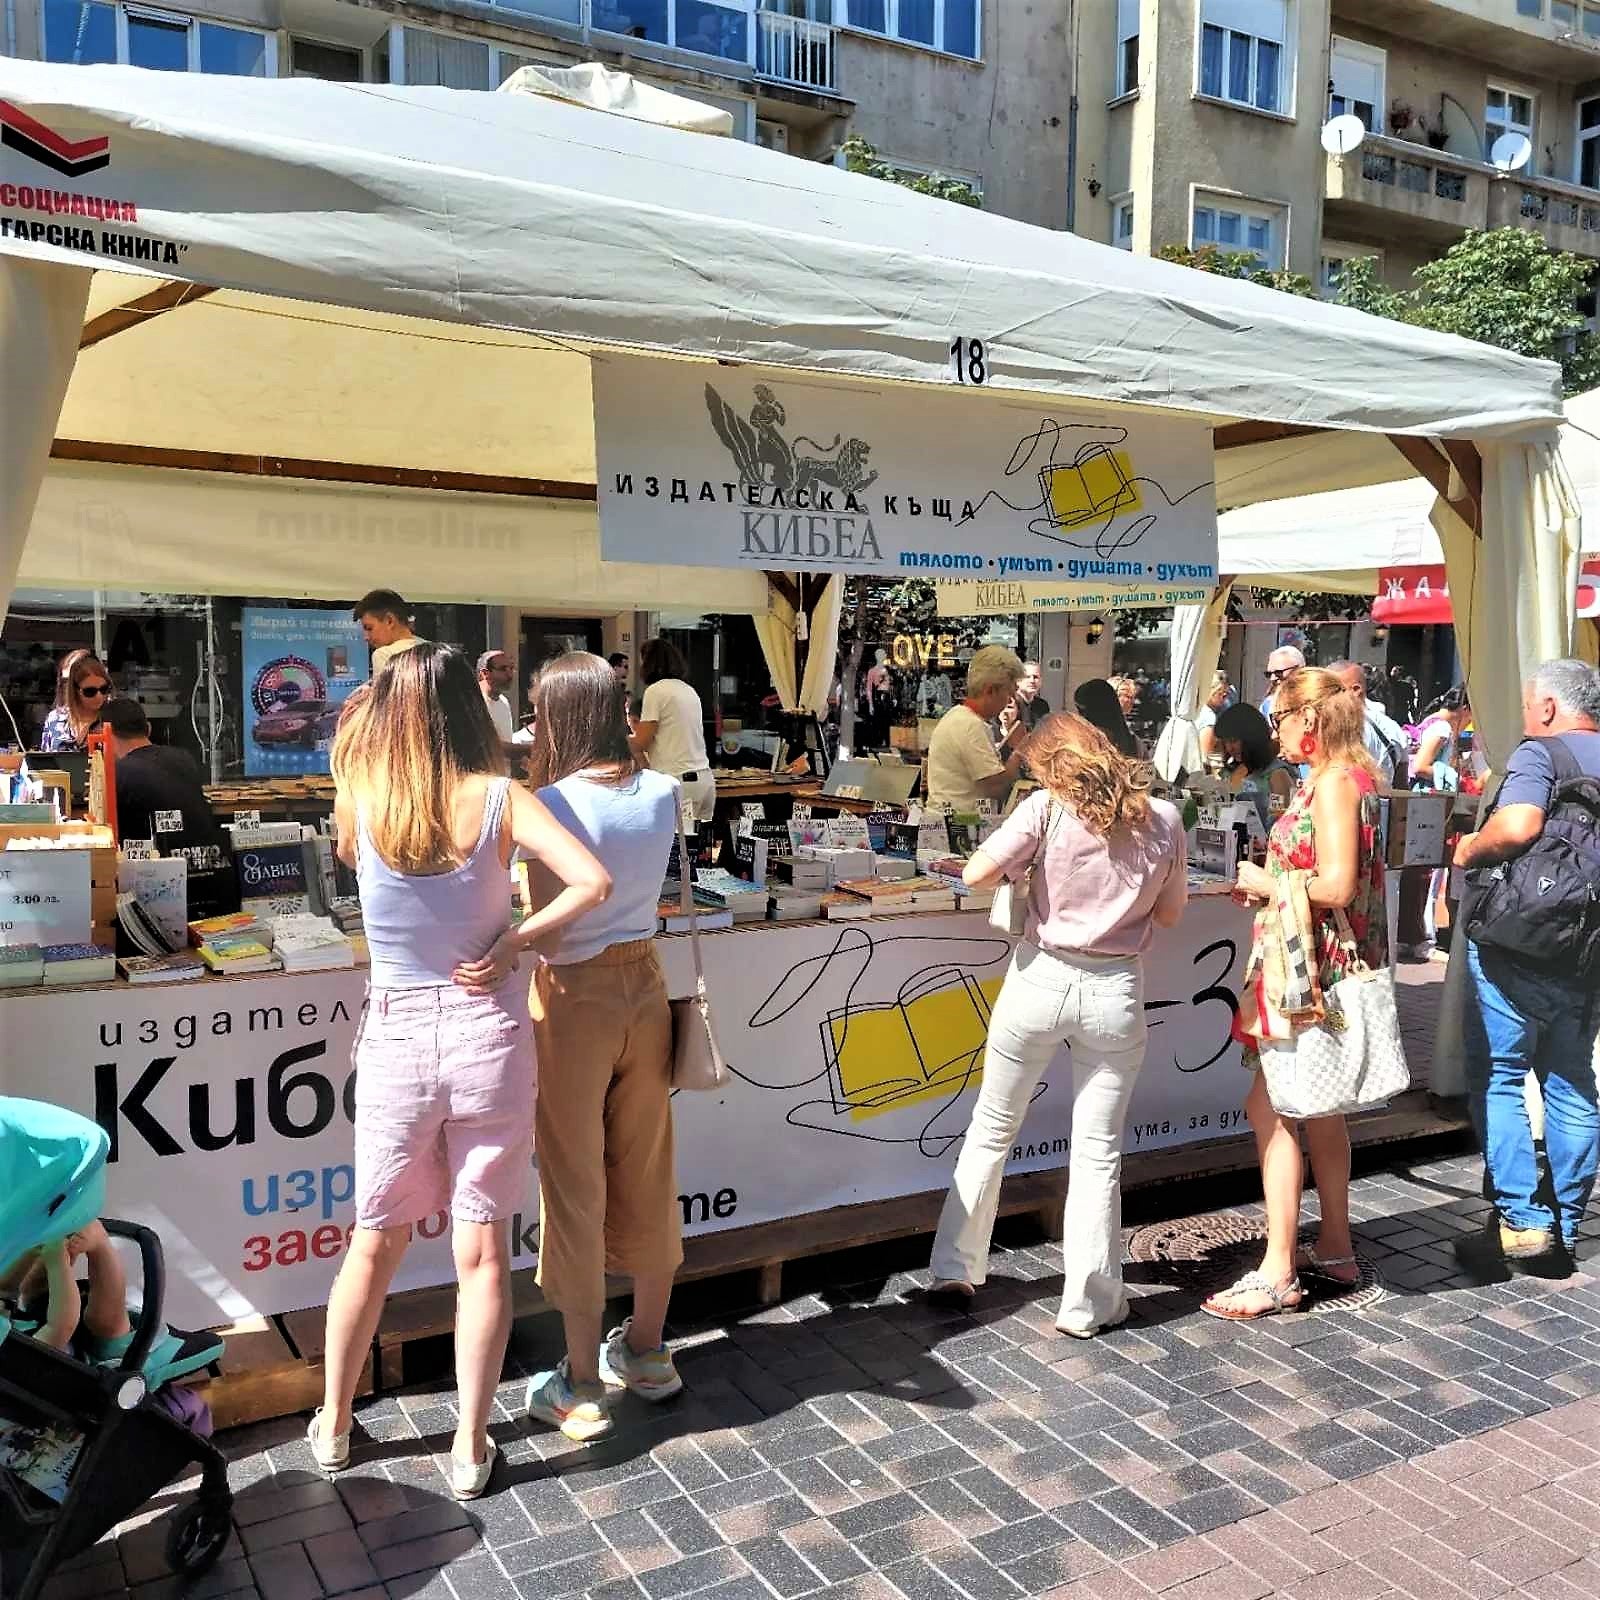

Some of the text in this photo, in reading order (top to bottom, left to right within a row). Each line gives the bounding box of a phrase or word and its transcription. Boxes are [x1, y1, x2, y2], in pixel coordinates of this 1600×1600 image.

[950, 336, 986, 384] 18
[615, 473, 976, 521] ИЗДАТЕЛСКА КЪЩА
[740, 510, 884, 560] КИБЕА
[900, 551, 1213, 582] тялото умът душата духът
[975, 584, 1026, 608] КИБЕА
[1112, 591, 1156, 607] душата
[1164, 588, 1206, 605] духът
[100, 998, 370, 1048] издател
[94, 1039, 356, 1164] Киб
[1189, 1114, 1209, 1129] за
